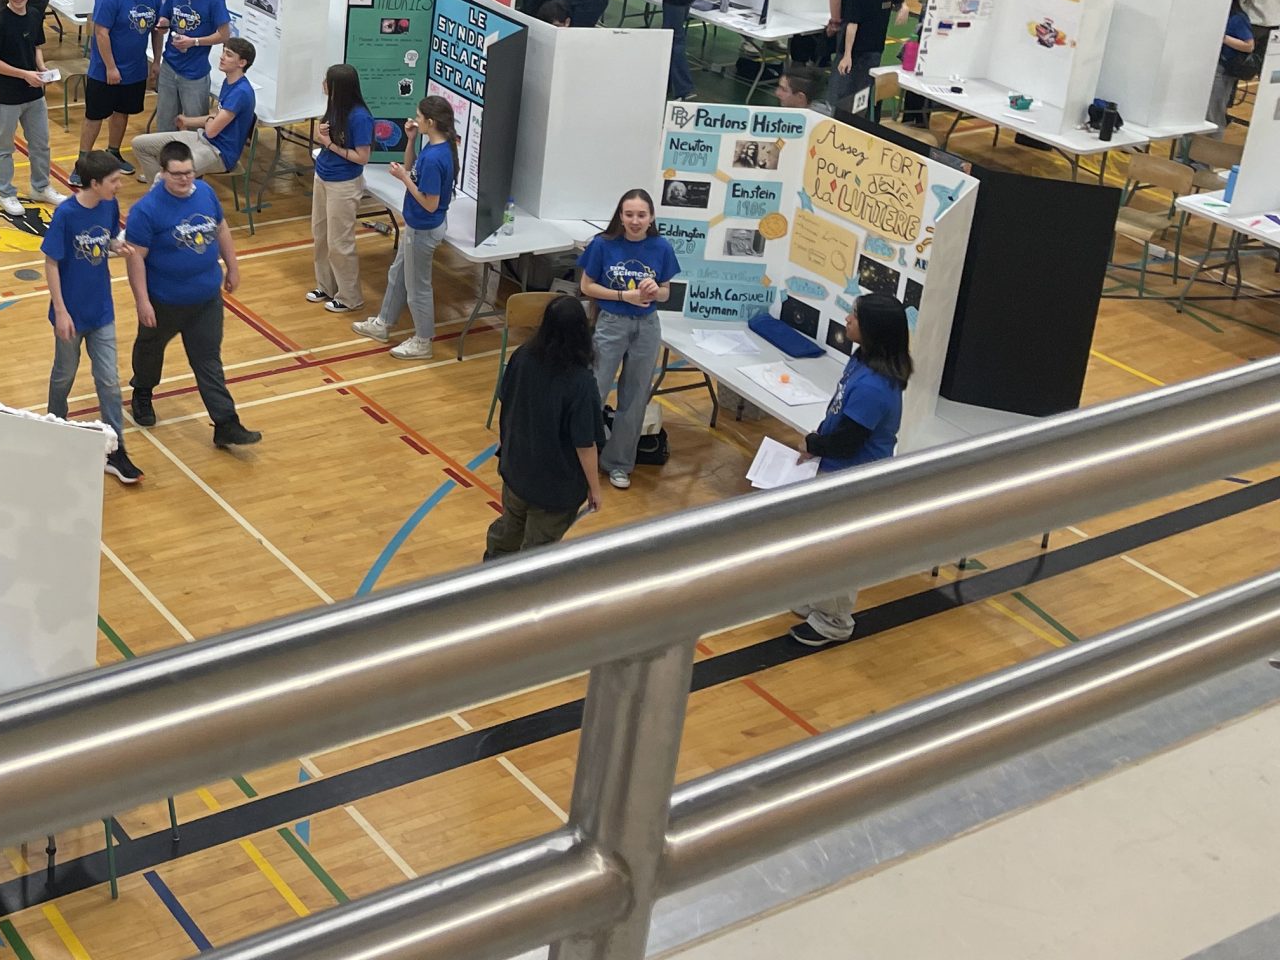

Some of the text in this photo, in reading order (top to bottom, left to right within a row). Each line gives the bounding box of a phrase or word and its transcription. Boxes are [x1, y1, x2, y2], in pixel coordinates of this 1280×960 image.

[468, 7, 488, 31] LE
[694, 107, 748, 131] Parlons
[752, 114, 804, 135] Histoire
[669, 137, 713, 153] Newton
[817, 124, 928, 180] Assez FORT
[816, 157, 852, 180] pour
[732, 182, 776, 200] Einstein
[811, 177, 834, 206] la
[658, 222, 706, 242] Eddington
[724, 288, 775, 304] Carswell
[689, 301, 739, 318] Weymann
